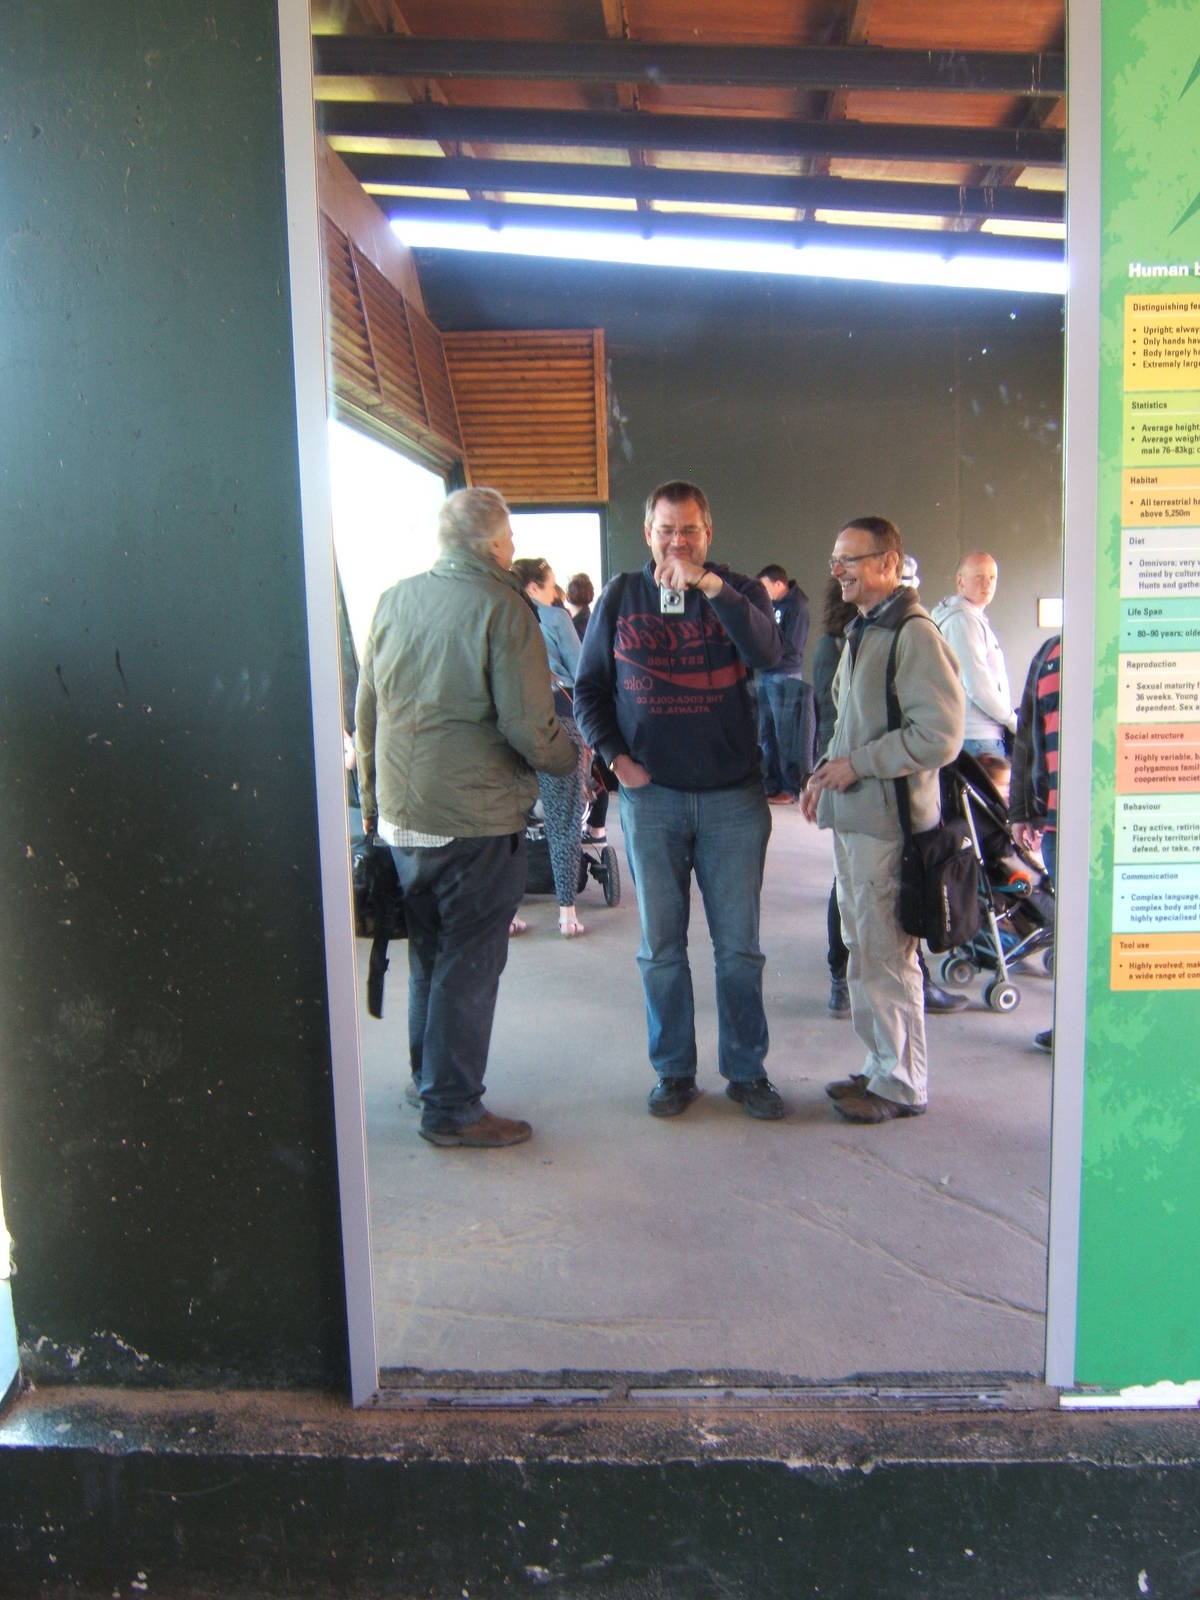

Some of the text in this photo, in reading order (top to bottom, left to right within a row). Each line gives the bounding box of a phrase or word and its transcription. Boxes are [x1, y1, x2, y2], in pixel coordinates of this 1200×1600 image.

[1128, 262, 1189, 278] Human
[1133, 302, 1189, 312] Distinguishing
[1176, 325, 1200, 334] alway
[1143, 337, 1161, 347] Only
[1162, 336, 1185, 345] hands
[1143, 348, 1162, 358] Body
[1165, 347, 1191, 357] largely
[1143, 360, 1181, 369] Extremely
[1131, 401, 1168, 410] Statistics
[1141, 424, 1173, 433] Average
[1141, 435, 1173, 445] Average
[1141, 447, 1160, 455] male
[1130, 476, 1158, 484] Habitat
[1140, 498, 1152, 507] All
[1153, 497, 1191, 506] terrestrial
[1140, 510, 1191, 518] above 5,250m
[1128, 537, 1145, 545] Diet
[1179, 559, 1196, 568] very
[1139, 570, 1162, 579] mined
[1164, 570, 1173, 579] by
[1138, 581, 1160, 590] Hunts
[1162, 581, 1177, 589] and
[1127, 607, 1163, 617] Life Span
[1126, 660, 1177, 670] Reproduction
[1136, 682, 1163, 690] Sexual
[1164, 681, 1195, 691] maturity
[1175, 692, 1198, 702] Young
[1179, 703, 1194, 711] Sex
[1125, 732, 1184, 741] Social structure
[1134, 753, 1158, 763] Highly
[1134, 764, 1179, 774] polygamous
[1134, 774, 1177, 784] cooperative
[1123, 802, 1161, 811] Behaviour
[1132, 823, 1147, 833] Day
[1132, 834, 1162, 843] Fiercely
[1121, 872, 1179, 881] Communication
[1131, 893, 1163, 902] Complex
[1130, 903, 1162, 912] complex
[1164, 903, 1182, 912] body
[1183, 903, 1197, 911] and
[1130, 914, 1153, 924] highly
[1154, 913, 1197, 923] specialised
[1120, 940, 1150, 949] Tool use
[1128, 961, 1153, 970] Highly
[1135, 972, 1154, 980] wide
[1155, 972, 1177, 981] range
